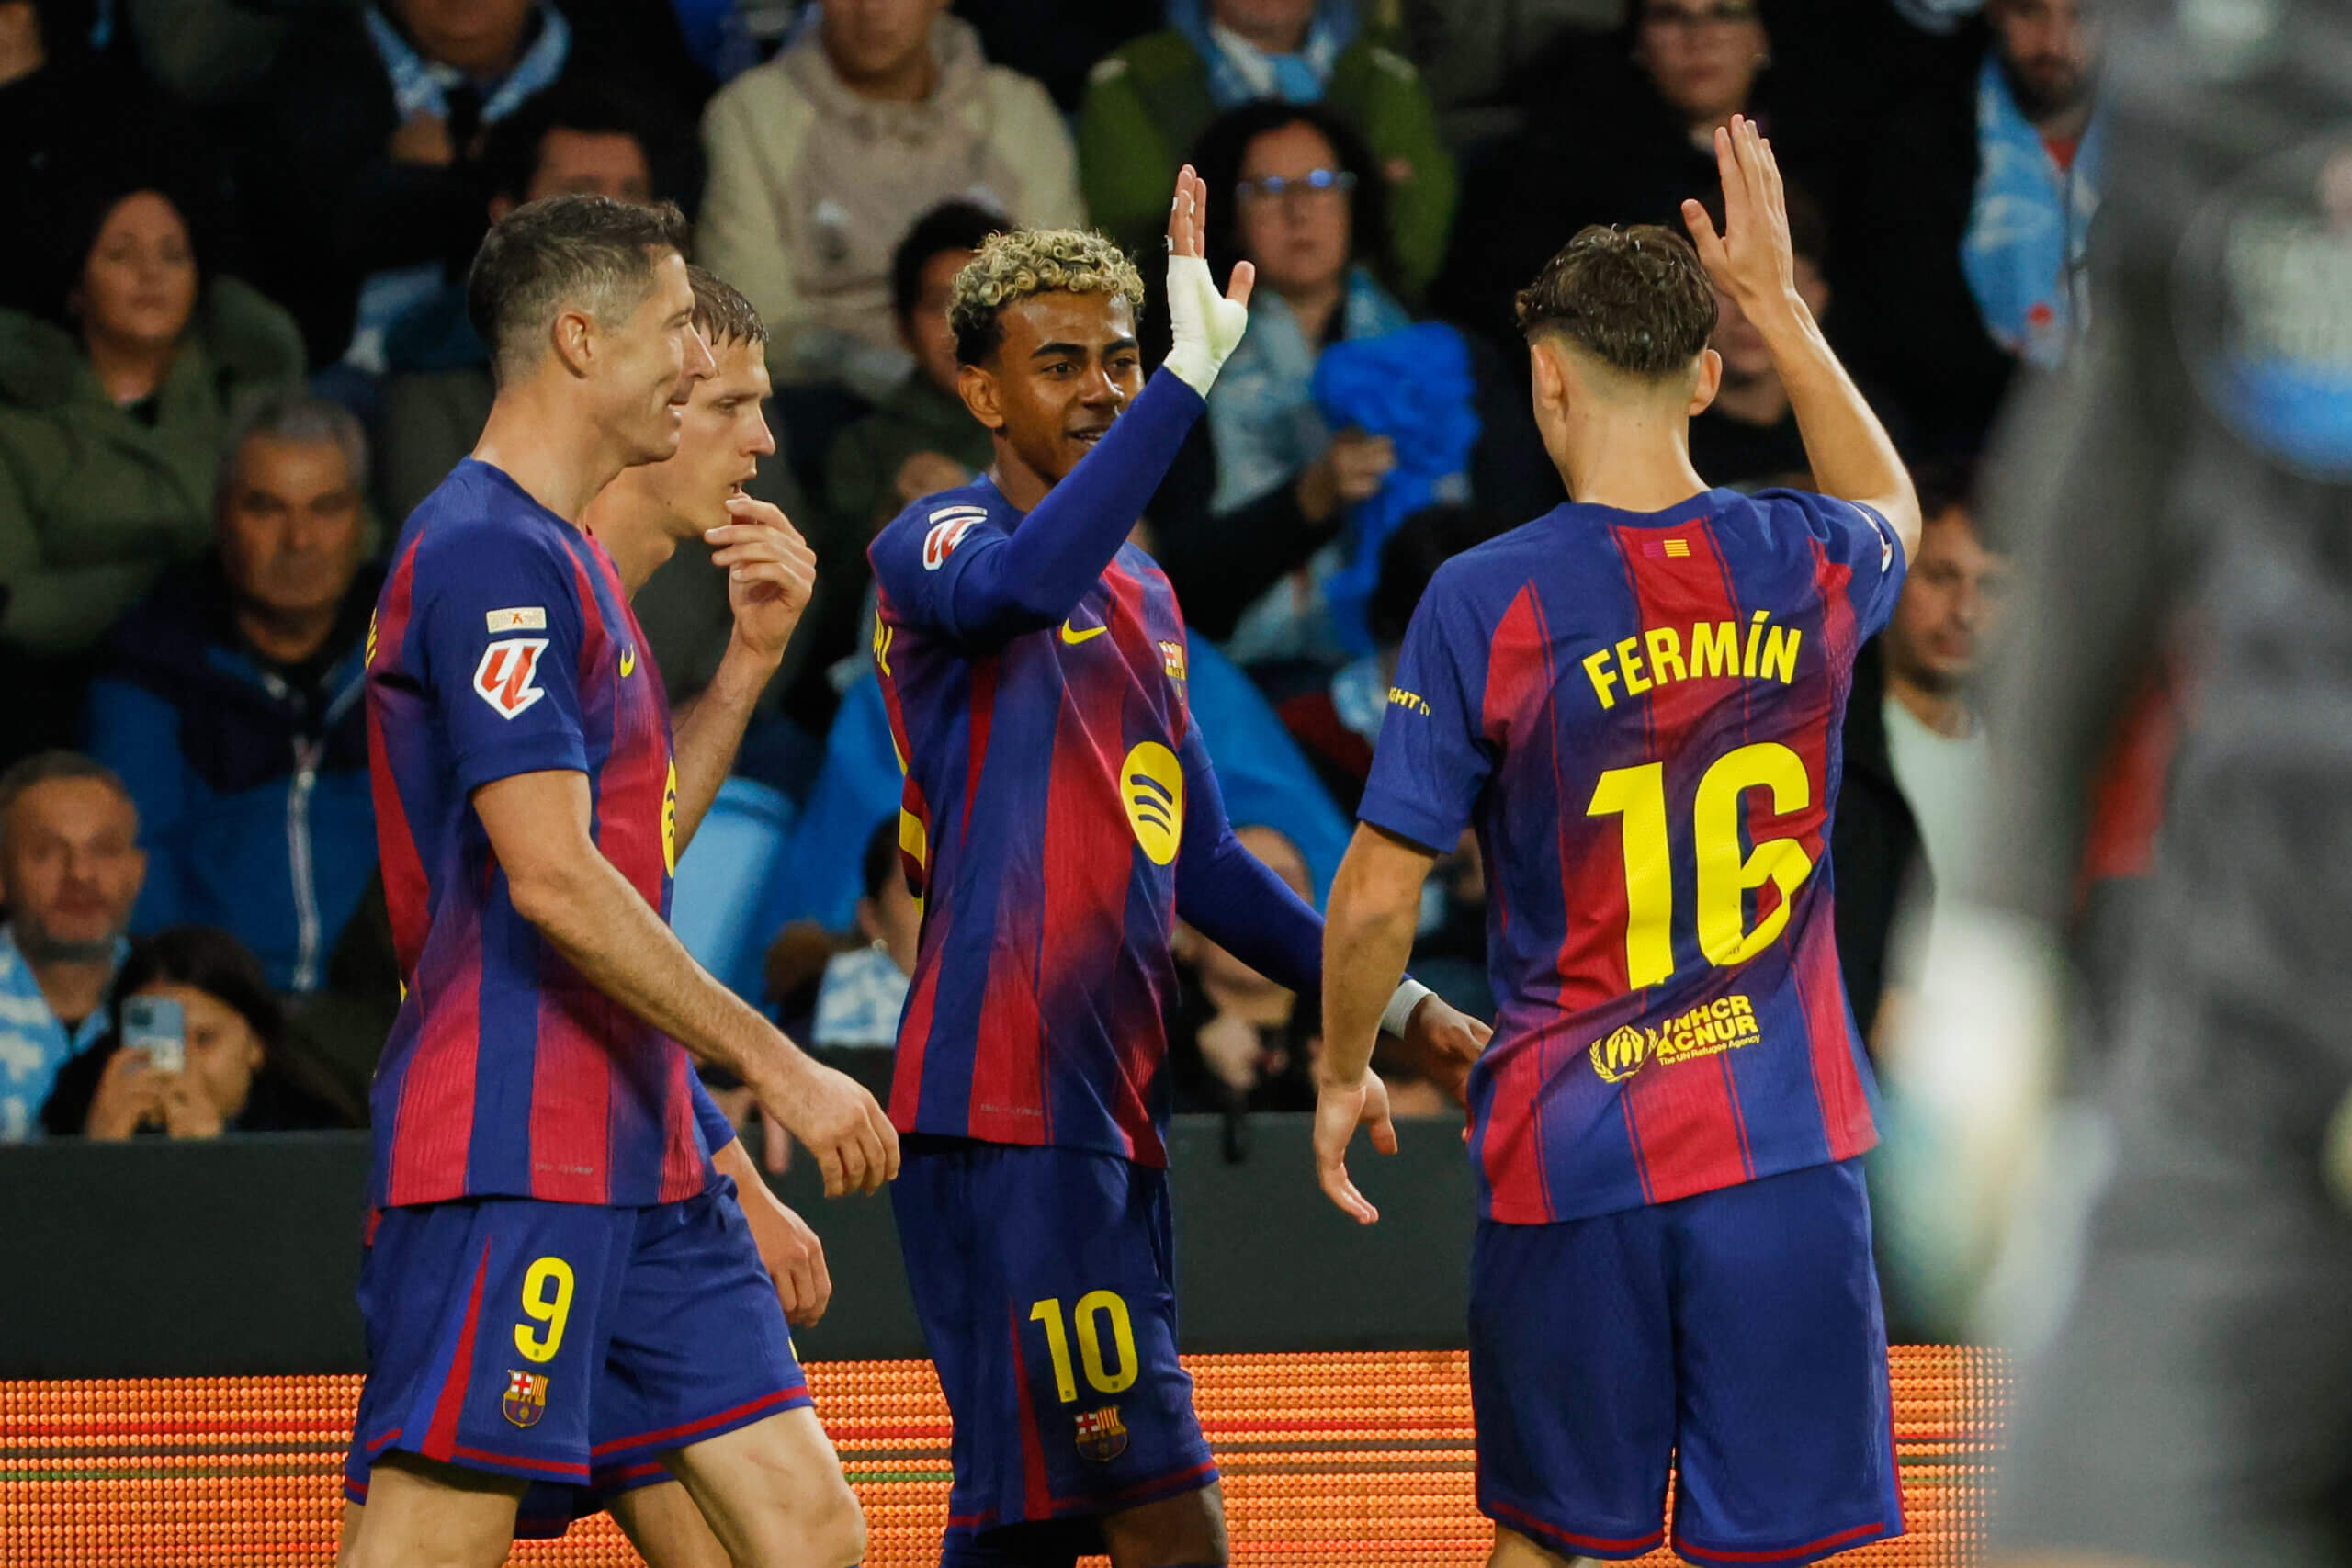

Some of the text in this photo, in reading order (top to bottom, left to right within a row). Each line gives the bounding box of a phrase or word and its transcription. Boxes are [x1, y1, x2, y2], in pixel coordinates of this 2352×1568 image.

[1581, 609, 1802, 710] FERMÍN
[1586, 742, 1813, 991] 16
[1656, 1014, 1759, 1058] ACNUR
[1657, 1034, 1761, 1066] The UN Refugee Agency
[514, 1256, 575, 1363] 9
[1028, 1289, 1139, 1404] 10
